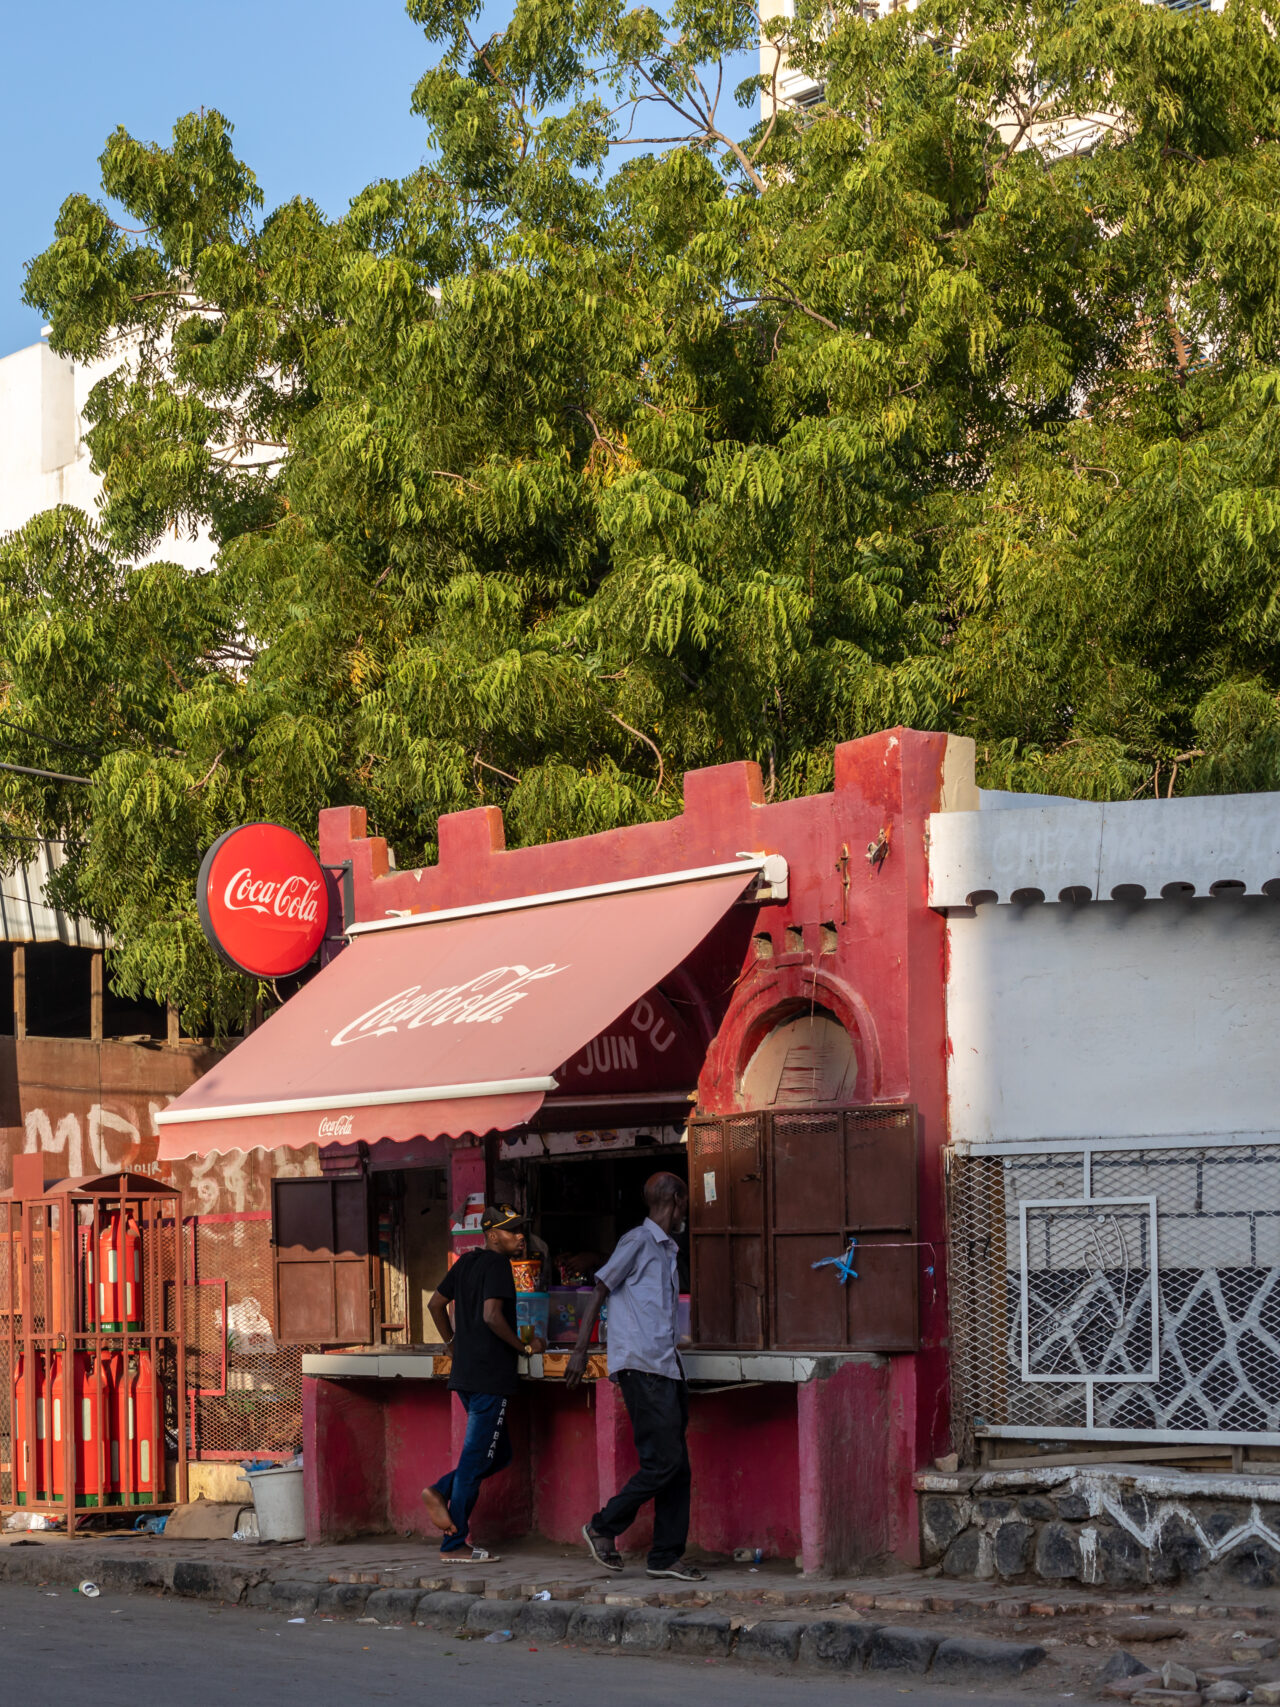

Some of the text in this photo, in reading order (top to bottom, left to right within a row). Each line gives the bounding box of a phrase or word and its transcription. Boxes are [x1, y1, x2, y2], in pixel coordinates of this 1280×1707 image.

[223, 867, 321, 923] Coca-Cola
[330, 962, 572, 1047] Coca-Cola
[630, 998, 677, 1053] DU
[577, 1035, 638, 1076] JUIN
[318, 1114, 356, 1138] Coca-Cola
[487, 1398, 507, 1460] BAR BAR
